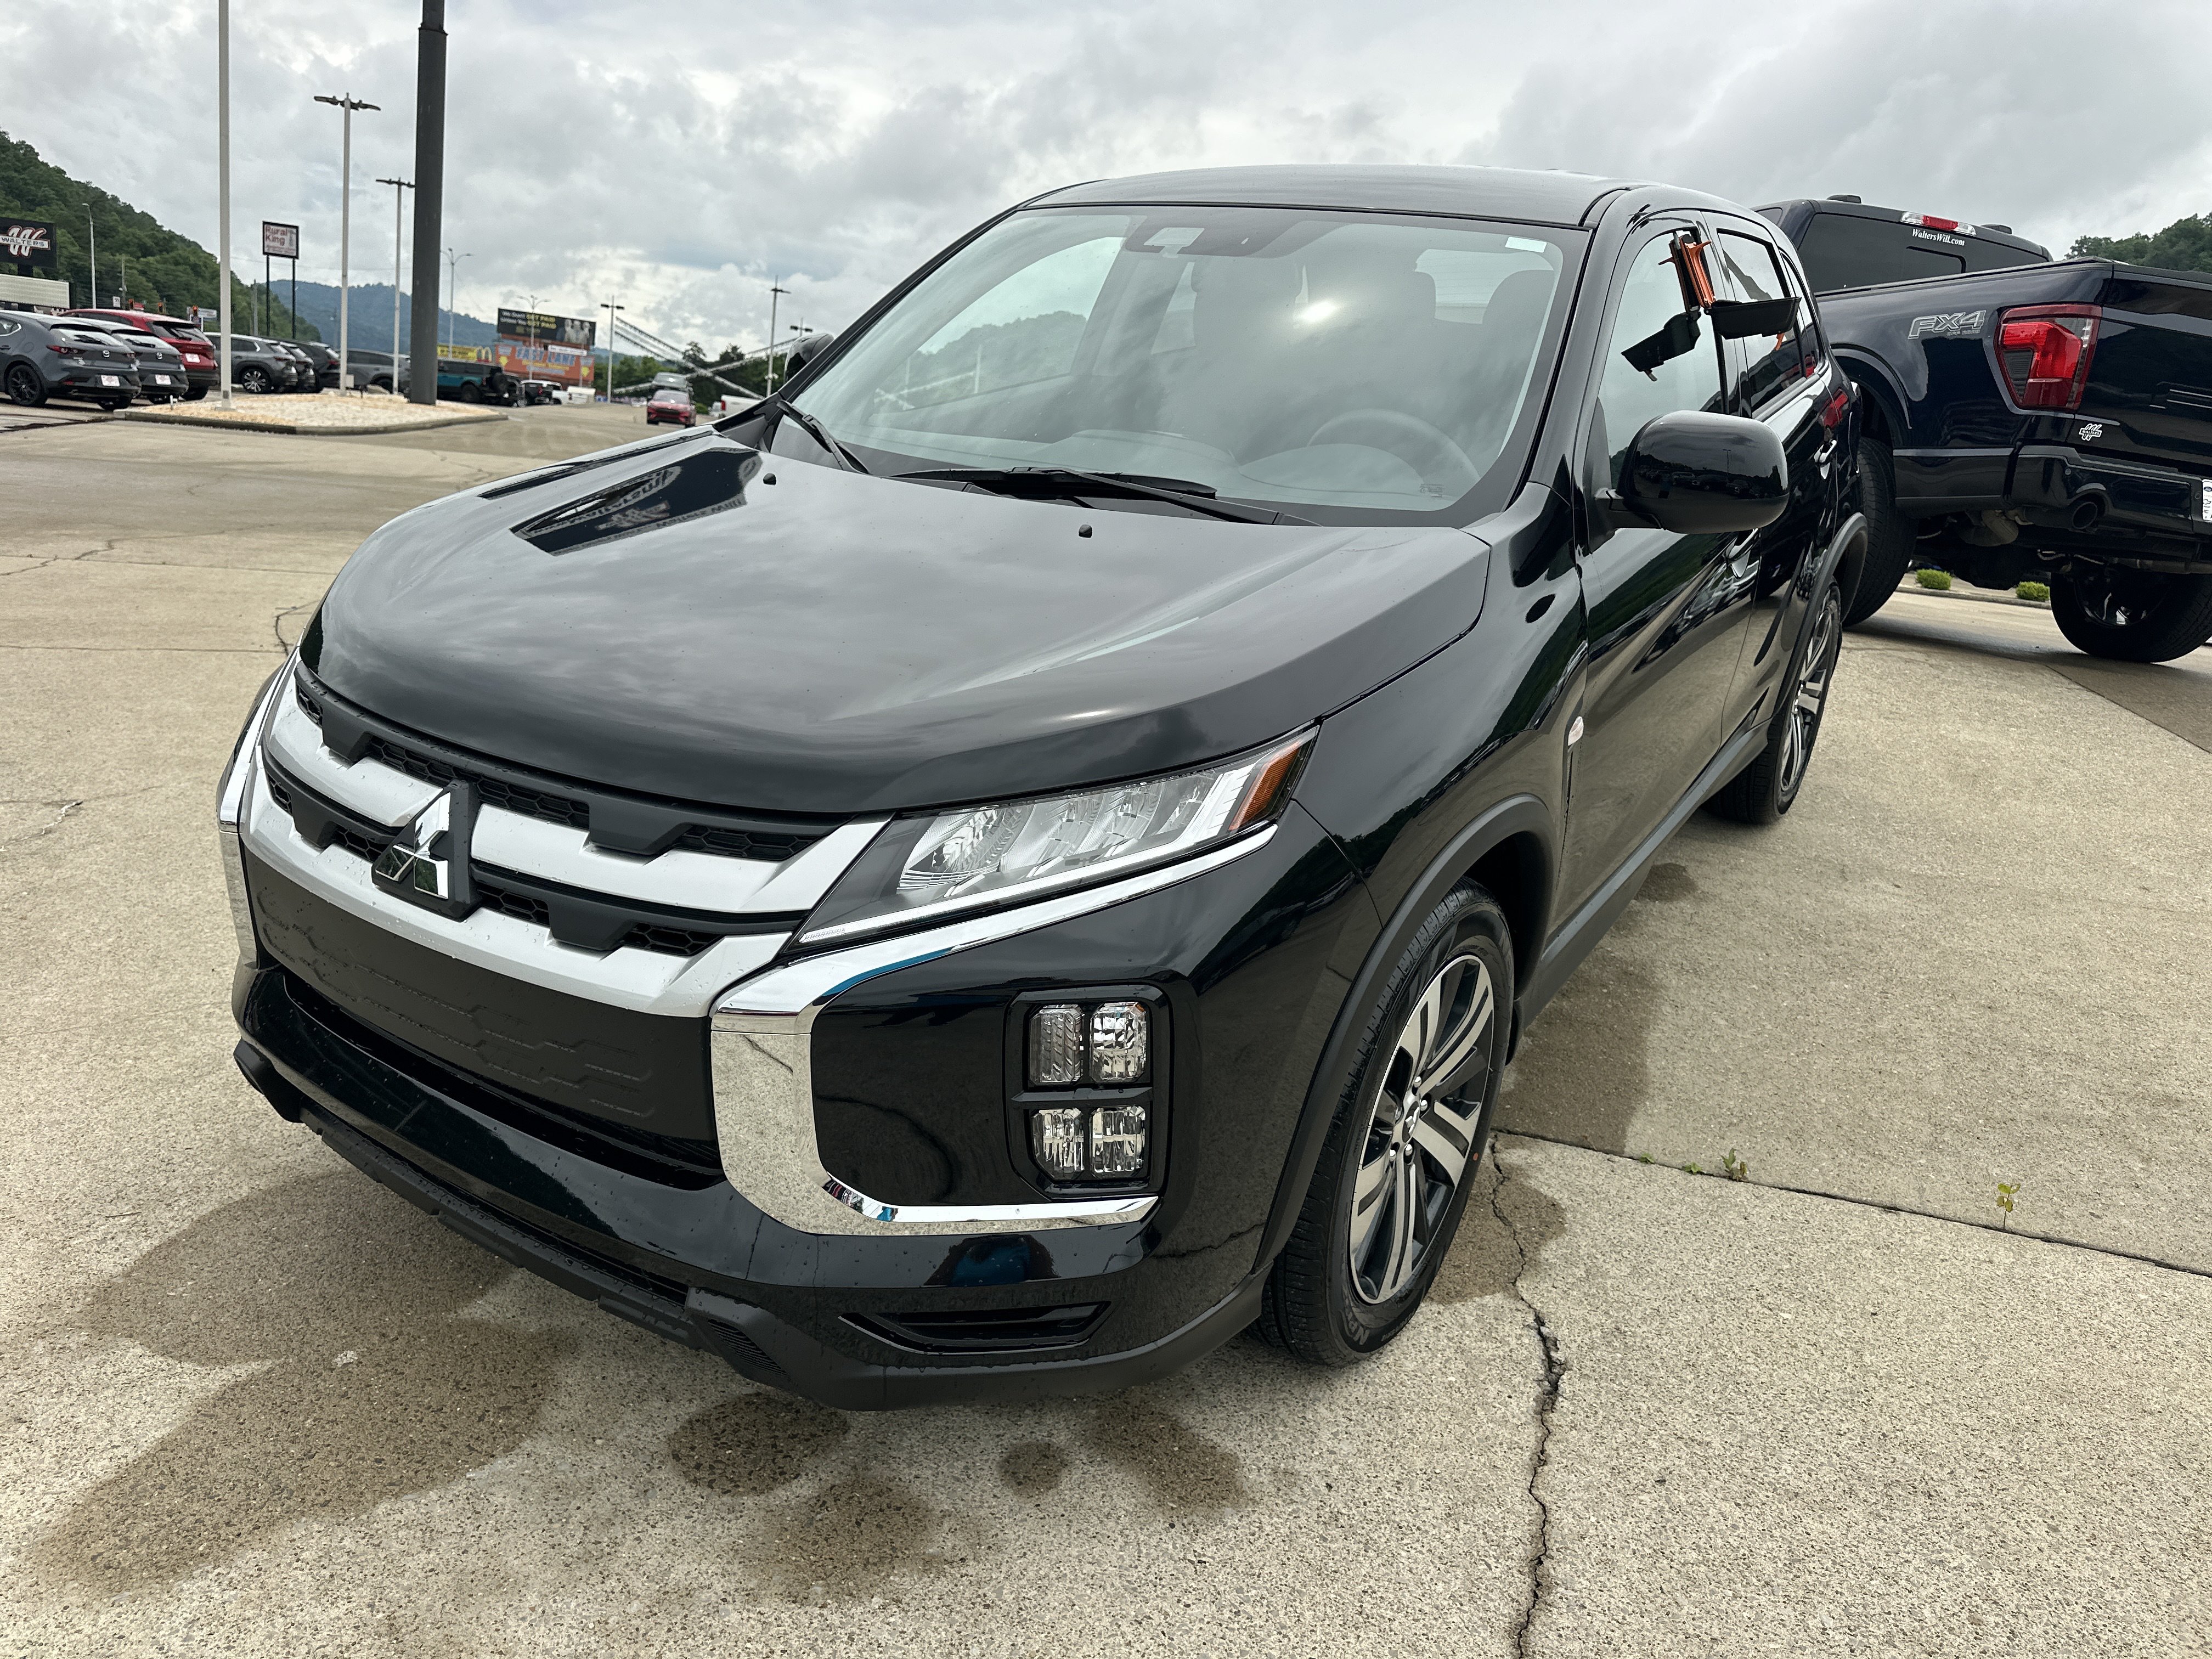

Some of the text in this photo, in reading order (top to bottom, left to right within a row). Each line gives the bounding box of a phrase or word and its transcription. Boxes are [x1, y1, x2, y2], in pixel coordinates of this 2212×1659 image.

[266, 226, 287, 236] Rural
[1912, 228, 1965, 246] WaltersWill.com
[1, 237, 44, 247] WALTERS
[266, 234, 285, 246] King
[1908, 310, 1987, 340] FX4
